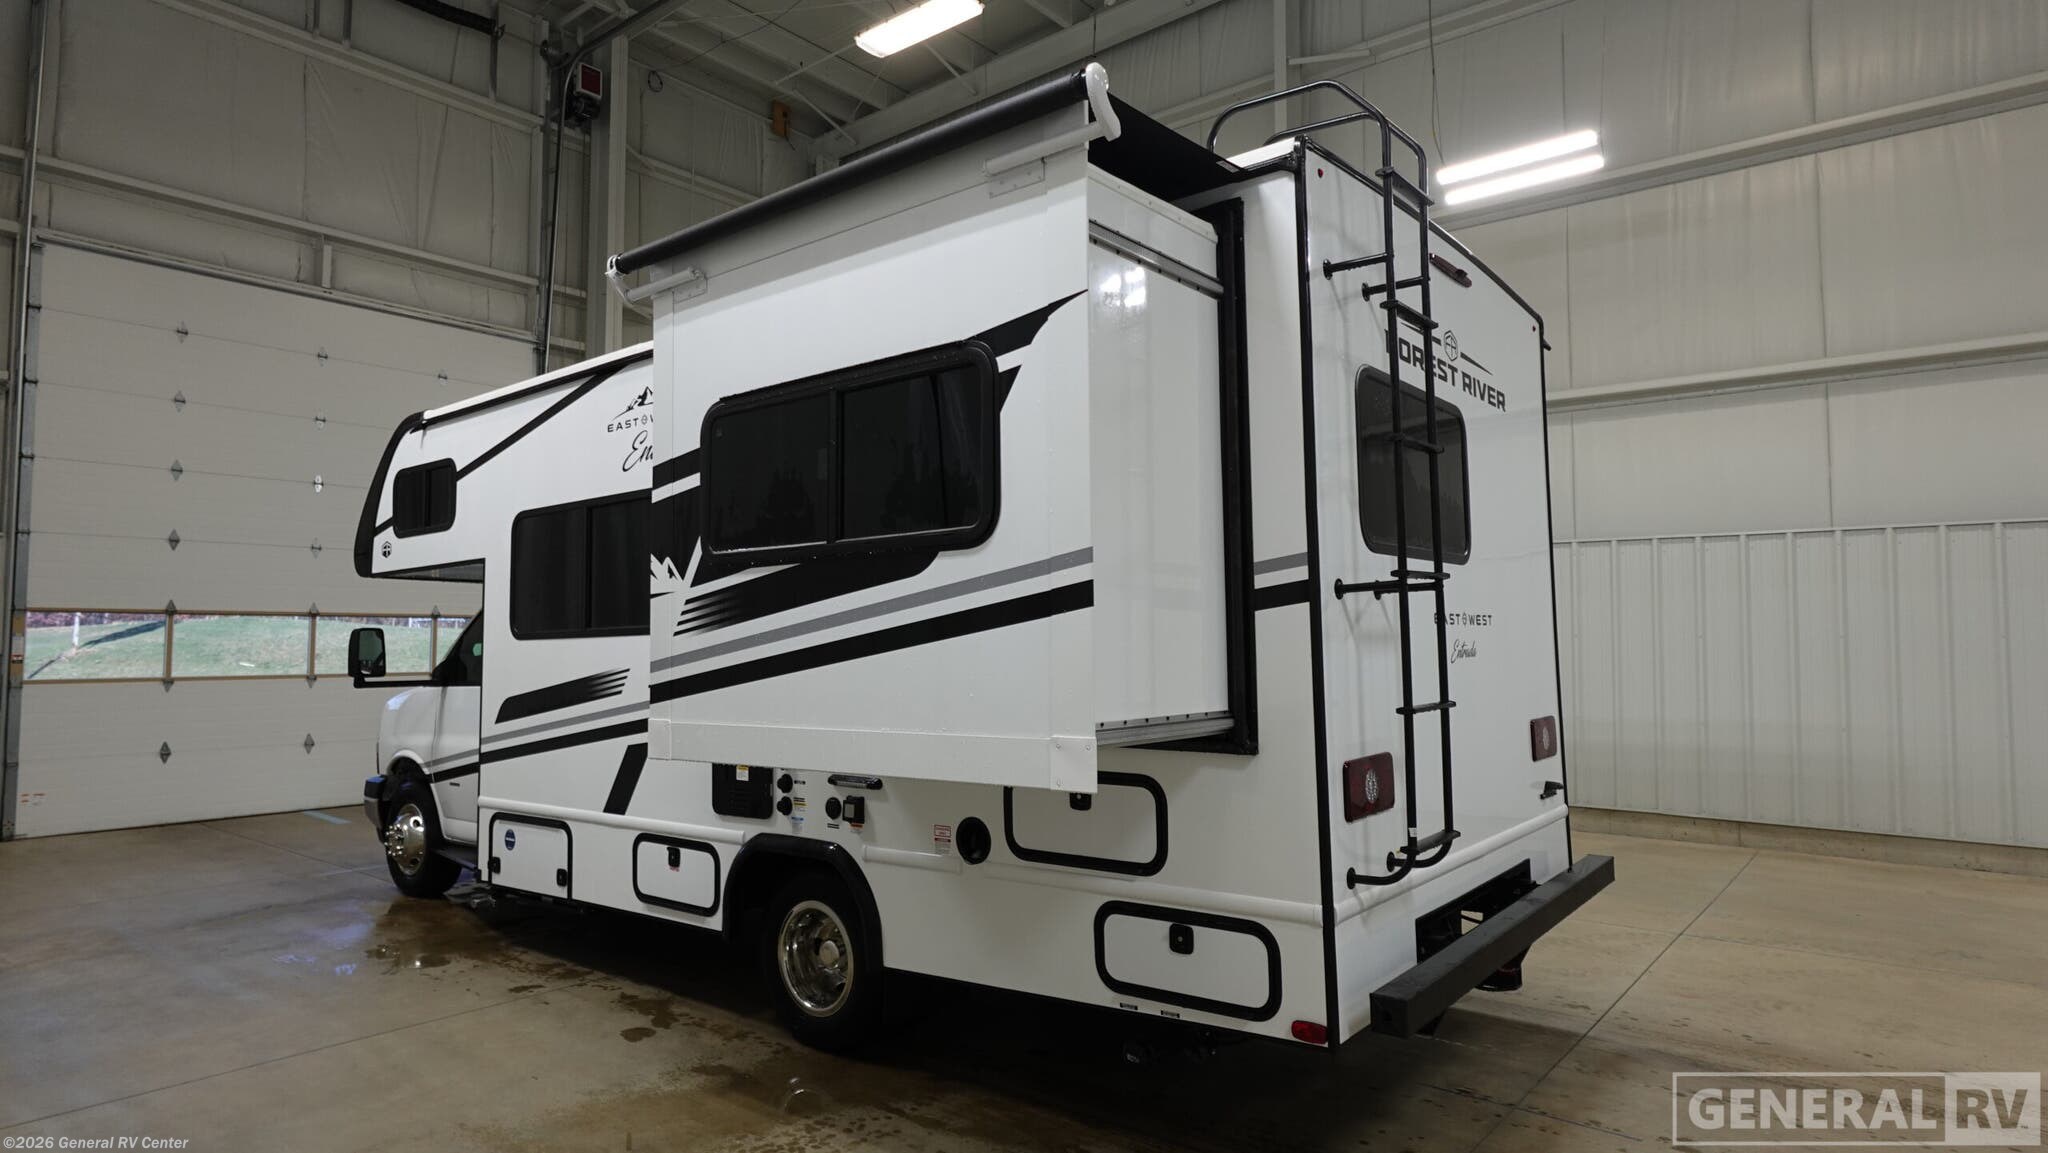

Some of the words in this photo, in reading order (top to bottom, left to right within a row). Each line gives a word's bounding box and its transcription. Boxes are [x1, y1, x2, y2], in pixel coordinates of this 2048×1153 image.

[1384, 329, 1458, 387] ORST
[1461, 371, 1506, 412] RIVER
[607, 417, 639, 433] EAST
[1468, 614, 1493, 626] WEST
